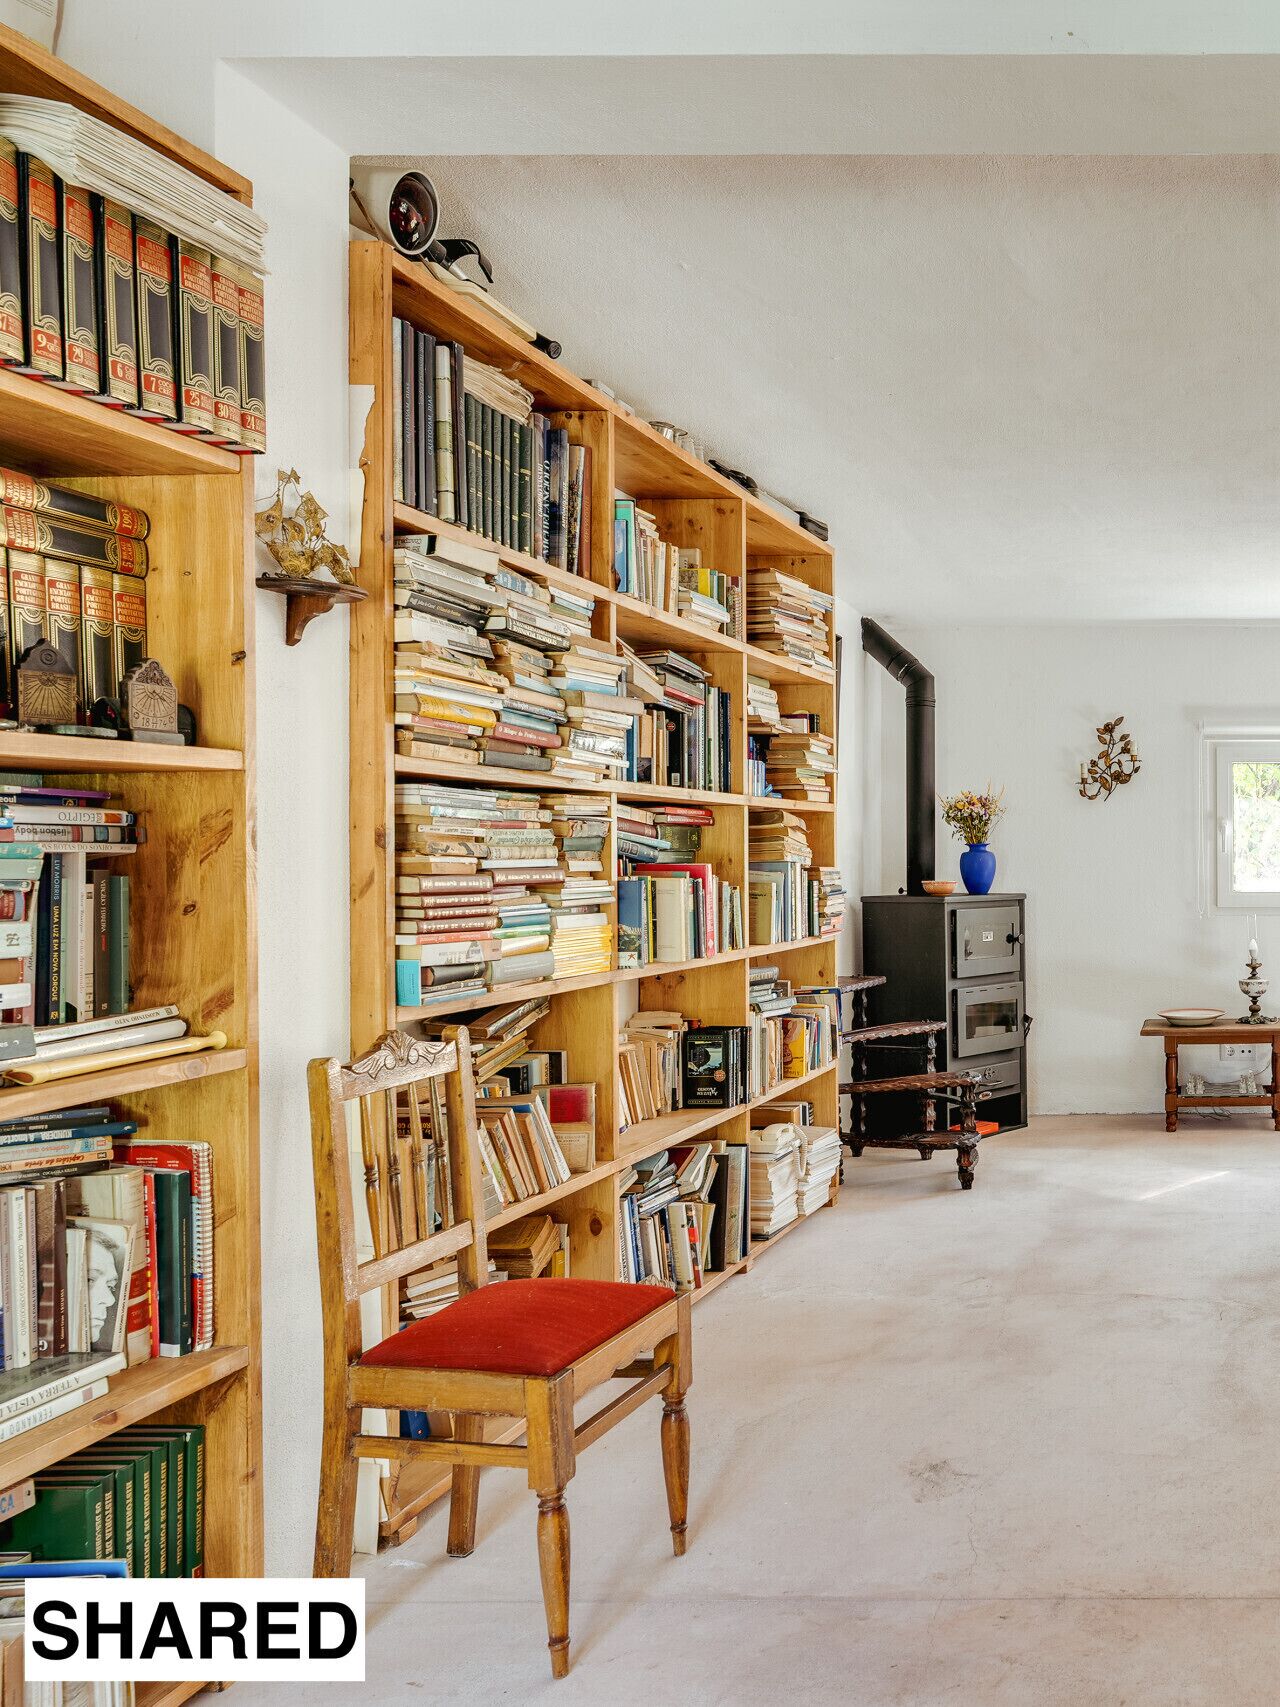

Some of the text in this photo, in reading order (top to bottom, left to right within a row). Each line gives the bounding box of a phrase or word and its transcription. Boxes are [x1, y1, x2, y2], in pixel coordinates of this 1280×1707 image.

[36, 334, 46, 347] 9
[72, 345, 84, 363] 29
[150, 377, 156, 392] 7
[58, 812, 96, 822] EGIPTO
[15, 826, 66, 837] lisbon body
[52, 939, 58, 950] EM
[40, 1130, 72, 1140] KUNDERA
[40, 1380, 72, 1398] TERRA
[6, 1396, 36, 1413] VISTA
[196, 1490, 202, 1503] DE
[176, 1500, 183, 1512] DE
[160, 1509, 166, 1522] DE
[144, 1520, 150, 1533] DE
[126, 1530, 132, 1543] DE
[104, 1542, 112, 1554] DE
